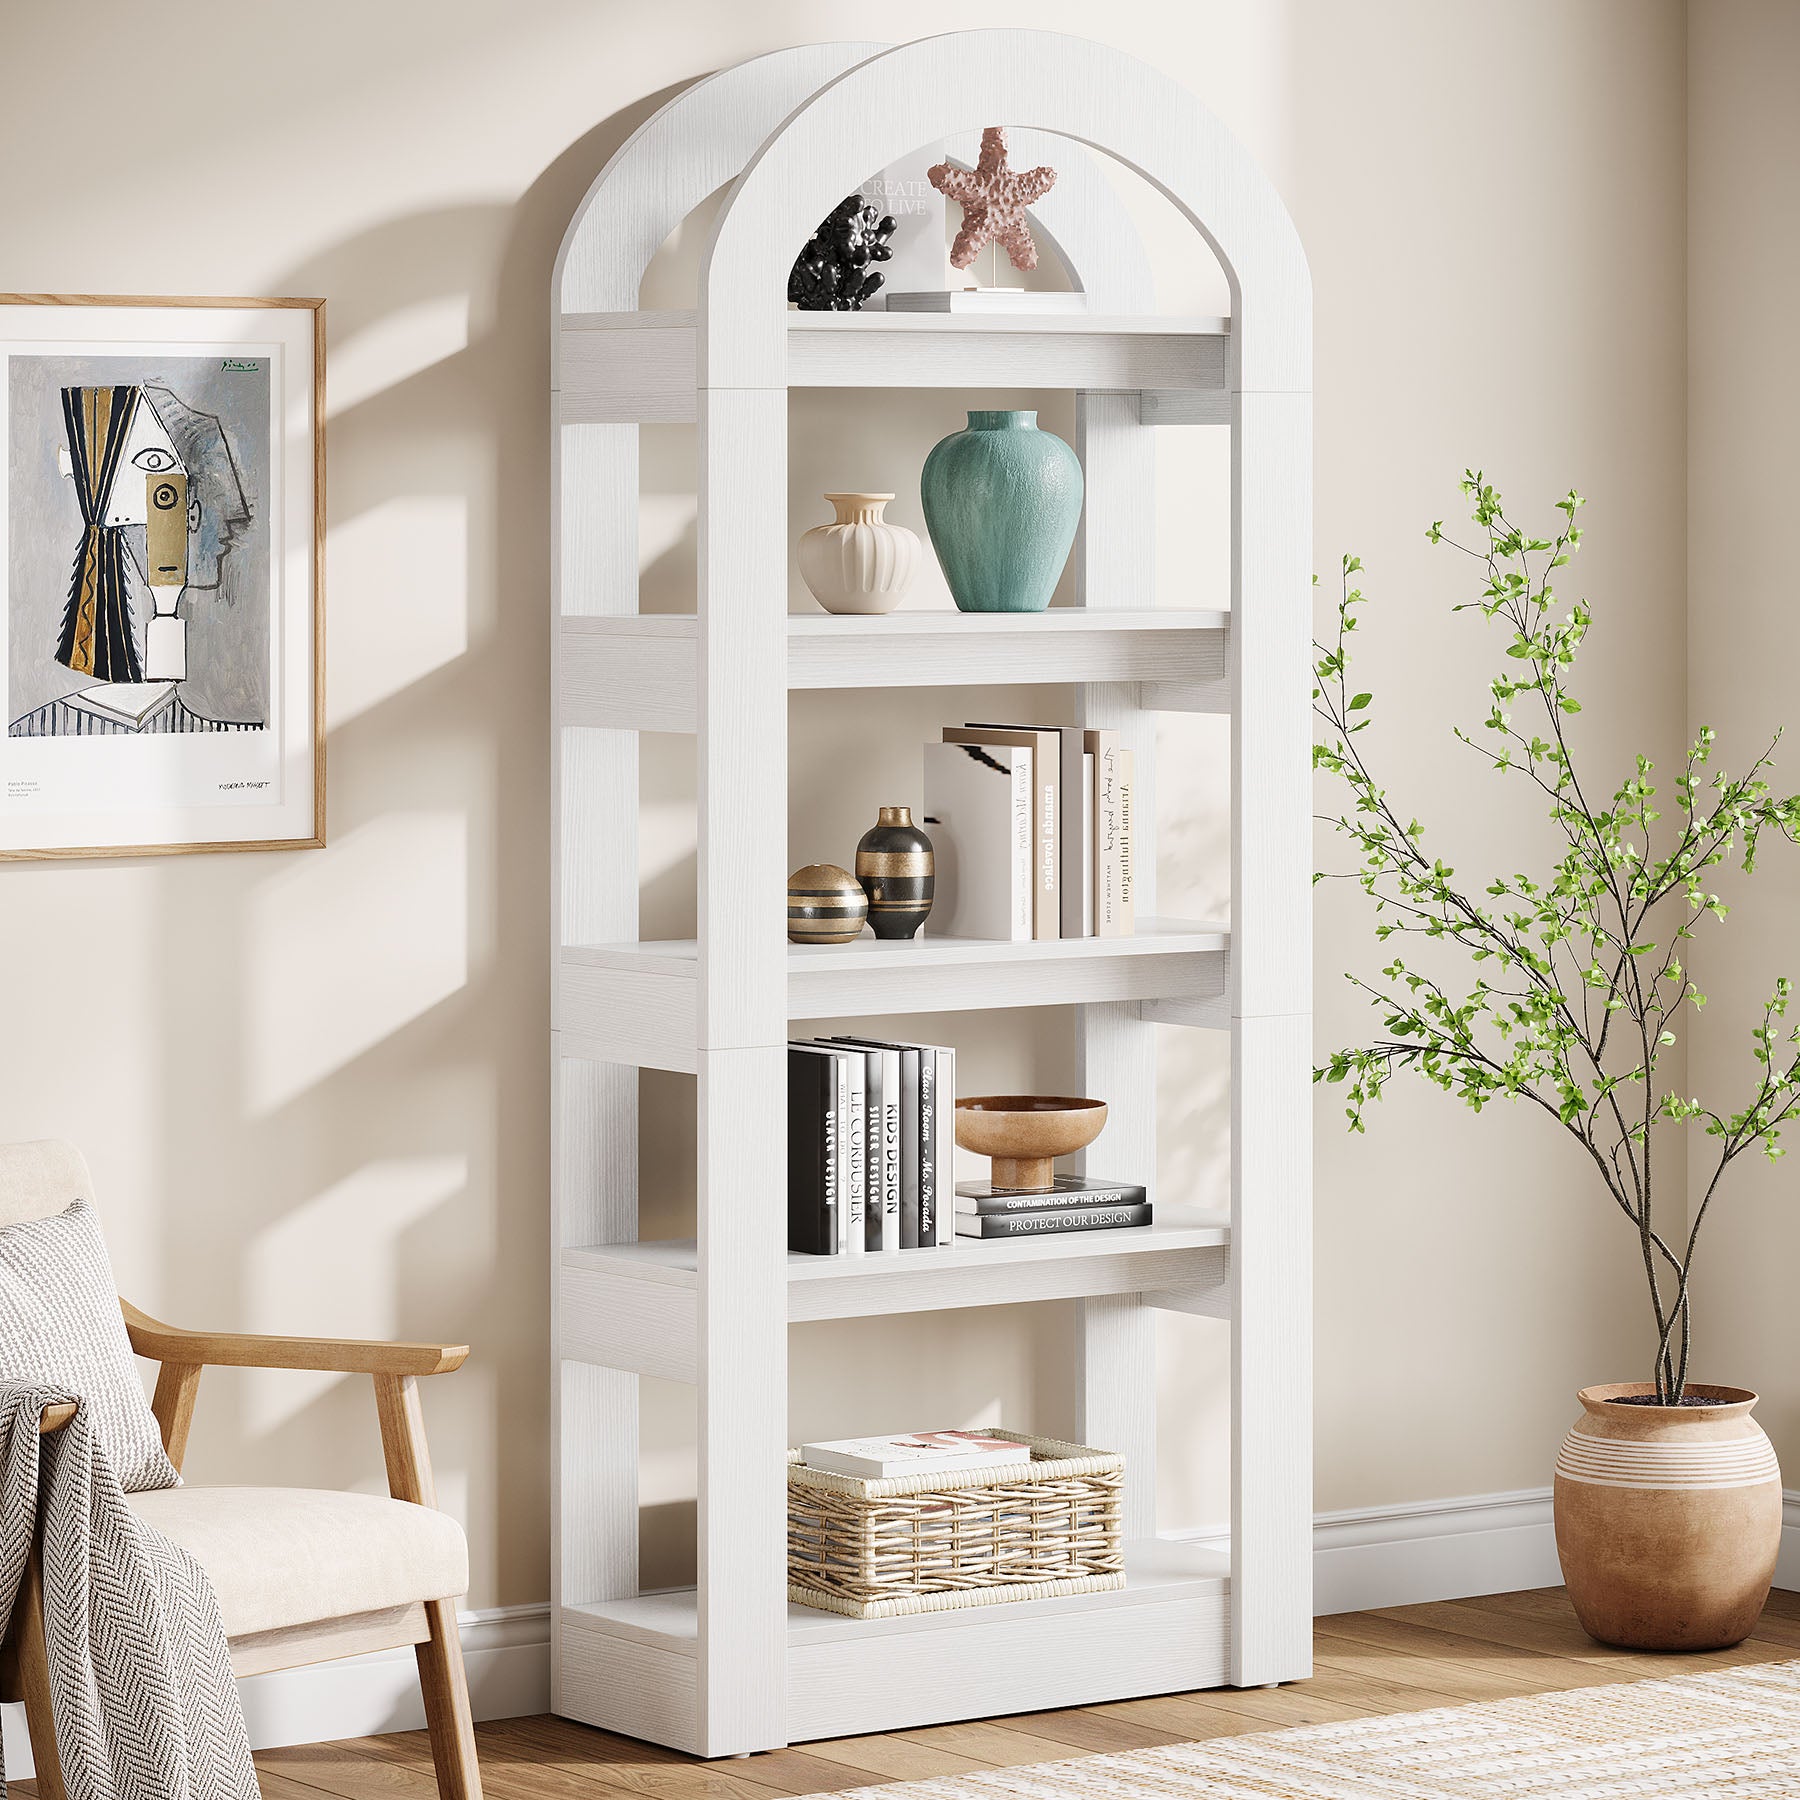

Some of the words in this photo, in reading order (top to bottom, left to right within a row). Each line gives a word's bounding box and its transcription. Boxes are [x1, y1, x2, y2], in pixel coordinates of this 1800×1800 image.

[861, 180, 928, 197] CREATE
[888, 199, 927, 216] LIVE
[851, 1091, 863, 1113] LE
[922, 1066, 933, 1100] Class
[826, 1111, 836, 1152] BLACK
[869, 1106, 880, 1150] SILVER
[886, 1104, 898, 1144] KIDS
[922, 1104, 933, 1142] Room
[826, 1158, 836, 1205] DESIGN
[851, 1118, 863, 1224] CORBUSIER
[869, 1157, 880, 1203] DESIGN
[886, 1150, 898, 1214] DESIGN
[922, 1185, 933, 1233] Posada
[1007, 1196, 1068, 1209] CONTAMINATION
[1068, 1195, 1079, 1205] OF
[1079, 1194, 1094, 1204] THE
[1094, 1193, 1122, 1203] DESIGN
[1009, 1217, 1061, 1231] PROTECT
[1062, 1215, 1089, 1227] OUR
[1091, 1212, 1132, 1225] DESIGN
